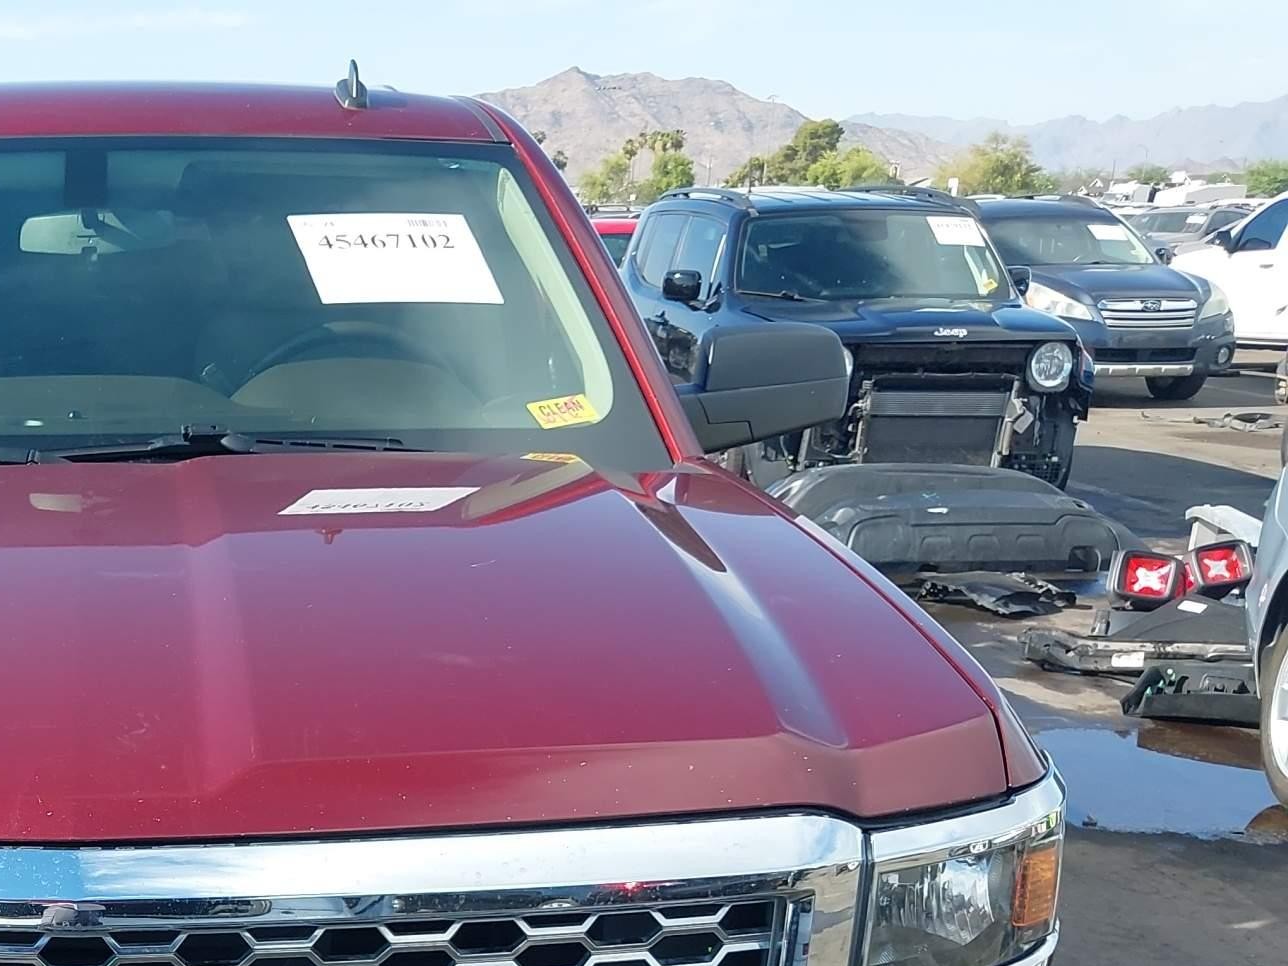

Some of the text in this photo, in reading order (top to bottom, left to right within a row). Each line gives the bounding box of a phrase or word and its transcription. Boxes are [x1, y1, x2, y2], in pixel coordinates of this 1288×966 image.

[318, 233, 455, 249] 45467102
[933, 327, 968, 338] Jeep
[538, 399, 585, 417] CLEAN
